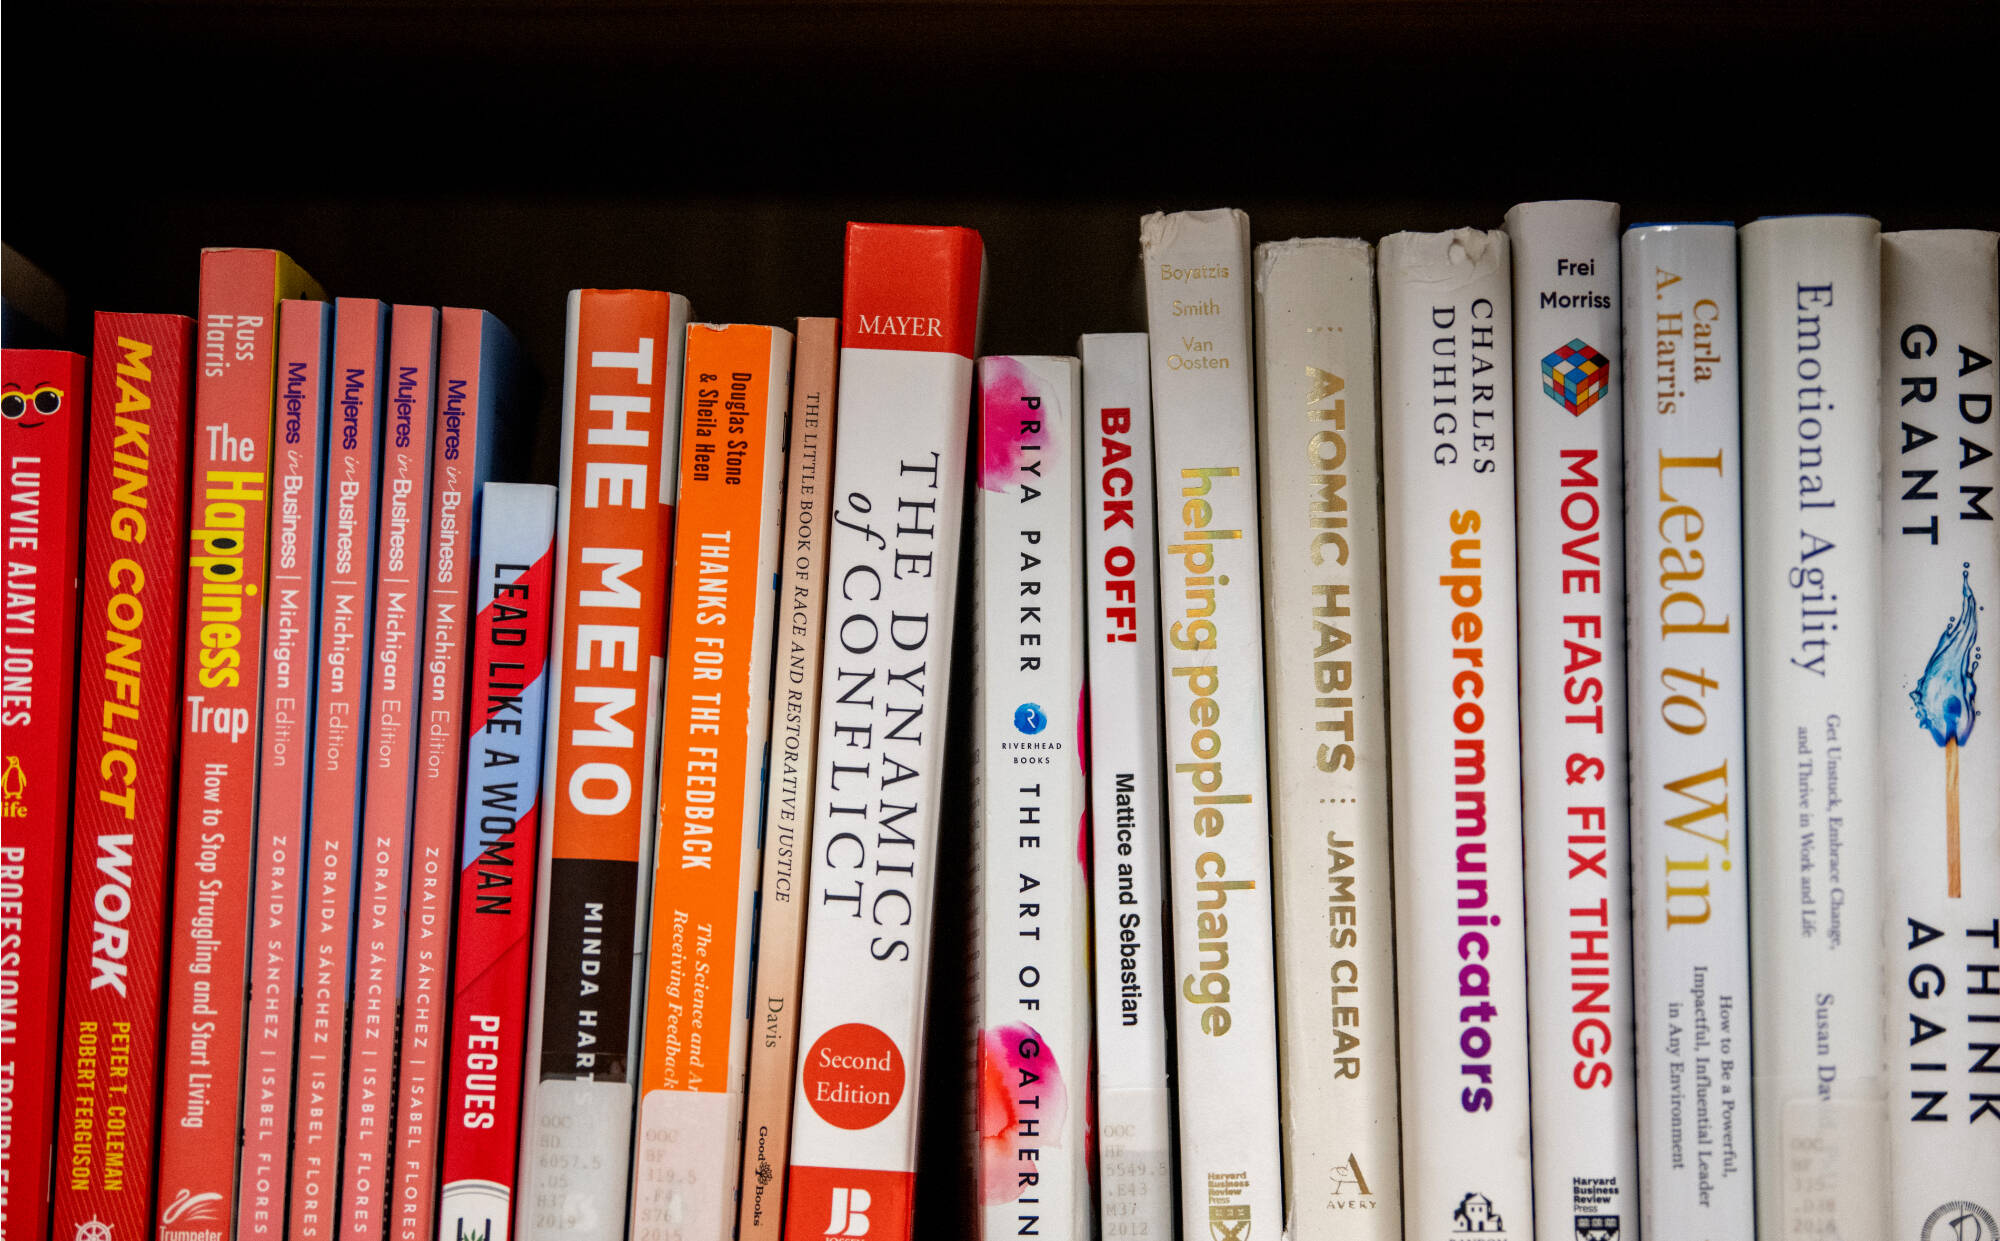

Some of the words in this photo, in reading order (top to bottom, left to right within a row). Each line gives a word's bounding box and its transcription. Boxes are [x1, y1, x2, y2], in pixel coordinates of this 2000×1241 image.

[1160, 264, 1230, 282] Boyatzis
[1540, 291, 1611, 309] Morriss
[1557, 258, 1595, 276] Frei
[1655, 267, 1683, 303] A.
[236, 315, 263, 361] Russ
[857, 314, 943, 338] MAYER
[1171, 300, 1221, 317] Smith
[1693, 298, 1720, 383] Carla
[205, 314, 234, 378] Harris
[1166, 354, 1230, 370] Oosten
[1182, 337, 1214, 352] Van
[1657, 311, 1685, 415] Harris
[283, 362, 307, 444] Mujeres
[442, 379, 467, 461] Mujeres
[697, 389, 718, 438] Sheila
[725, 373, 752, 434] Douglas
[805, 392, 820, 428] THE
[1432, 305, 1458, 466] DUHIGG
[1471, 297, 1496, 474] CHARLES
[1797, 282, 1836, 511] Emotional
[110, 336, 152, 544] MAKING
[206, 423, 255, 463] The
[584, 337, 654, 510] THE
[1020, 396, 1041, 504] PRIYA
[1900, 324, 1939, 545] GRANT
[1958, 344, 1994, 523] ADAM
[694, 443, 715, 482] Heen
[726, 440, 748, 486] Stone
[801, 434, 818, 495] LITTLE
[1100, 406, 1134, 532] BACK
[1305, 366, 1349, 568] ATOMIC
[9, 457, 41, 551] LUVVIE
[280, 475, 303, 569] Business
[438, 491, 461, 583] Business
[797, 501, 813, 551] BOOK
[834, 491, 886, 551] of
[893, 451, 940, 580] THE
[1559, 449, 1600, 594] MOVE
[191, 471, 264, 688] Happiness
[696, 530, 731, 627] THANKS
[796, 557, 809, 582] OF
[1167, 466, 1243, 652] helping
[1658, 448, 1730, 642] Lead
[6, 562, 37, 634] AJAYI
[492, 562, 529, 647] LEAD
[791, 586, 809, 637] RACE
[1020, 529, 1041, 672] PARKER
[1104, 545, 1137, 644] OFF!
[1788, 530, 1839, 678] Agility
[273, 589, 300, 689] Michigan
[429, 603, 456, 701] Michigan
[692, 638, 724, 682] FOR
[790, 640, 805, 684] AND
[1562, 615, 1604, 734] FAST
[1, 645, 33, 727] JONES
[100, 558, 145, 819] CONFLICT
[485, 662, 525, 738] LIKE
[568, 547, 643, 815] MEMO
[689, 691, 721, 735] THE
[1311, 584, 1355, 773] HABITS
[1660, 667, 1720, 736] to
[188, 696, 249, 743] Trap
[274, 697, 295, 767] Edition
[428, 710, 450, 778] Edition
[781, 689, 803, 821] RESTORATIVE
[823, 564, 881, 918] CONFLICT
[1001, 742, 1062, 750] RIVERHEAD
[1172, 665, 1252, 838] people
[1797, 727, 1813, 755] and
[1826, 714, 1840, 742] Get
[204, 763, 228, 802] How
[483, 749, 520, 768] A
[870, 610, 929, 962] DYNAMICS
[1013, 756, 1051, 765] BOOKS
[1565, 753, 1605, 786] &
[1798, 759, 1813, 808] Thrive
[203, 808, 222, 826] to
[681, 746, 719, 871] FEEDBACK
[1019, 783, 1041, 849] THE
[1115, 773, 1135, 858] Mattice
[1439, 508, 1500, 1113] supercommunicators
[1567, 806, 1606, 880] FIX
[195, 833, 225, 873] Stop
[475, 782, 518, 916] WOMAN
[776, 824, 794, 903] JUSTICE
[1662, 758, 1732, 931] Win
[1800, 832, 1815, 872] Work
[1829, 816, 1843, 883] Embrace
[90, 834, 133, 998] WORK
[269, 836, 286, 929] ZORAIDA
[420, 847, 439, 939] ZORAIDA
[1019, 873, 1041, 941] ART
[1118, 863, 1138, 905] and
[1326, 831, 1356, 948] JAMES
[1801, 877, 1816, 905] and
[189, 879, 222, 974] Struggling
[579, 902, 604, 998] MINDA
[666, 909, 689, 999] Receiving
[696, 923, 712, 958] The
[1182, 851, 1256, 1037] change
[1801, 910, 1816, 938] Life
[192, 981, 218, 1015] and
[264, 940, 284, 1039] SÁNCHEZ
[414, 951, 434, 1048] SÁNCHEZ
[691, 961, 710, 1029] Science
[1018, 965, 1041, 1011] OF
[1120, 913, 1141, 1027] Sebastian
[1570, 897, 1613, 1090] THINGS
[190, 1021, 215, 1067] Start
[766, 996, 784, 1048] Davis
[1330, 959, 1360, 1080] CLEAR
[1666, 1024, 1683, 1057] Any
[1669, 1003, 1683, 1018] in
[1690, 966, 1710, 1051] Impactful,
[1720, 995, 1732, 1029] How
[1815, 993, 1834, 1056] Susan
[1908, 918, 1948, 1123] AGAIN
[1966, 919, 2000, 1124] THINK
[77, 1021, 98, 1090] ROBERT
[111, 1022, 131, 1078] PETER
[463, 1015, 500, 1130] PEGUES
[663, 1002, 683, 1089] Feedback
[689, 1033, 704, 1068] and
[819, 1047, 892, 1071] Second
[1720, 1034, 1731, 1055] to
[1721, 1060, 1734, 1080] Be
[108, 1084, 128, 1098] T.
[181, 1074, 212, 1129] Living
[259, 1068, 276, 1140] ISABEL
[408, 1077, 424, 1148] ISABEL
[816, 1081, 890, 1105] Edition
[1670, 1062, 1684, 1170] Environment
[1696, 1057, 1713, 1144] Influential
[71, 1097, 94, 1190] FERGUSON
[104, 1105, 126, 1191] COLEMAN
[758, 1126, 768, 1161] Good
[1722, 1100, 1737, 1178] Powerful,
[254, 1153, 271, 1234] FLORES
[402, 1161, 419, 1240] FLORES
[753, 1185, 764, 1227] Books
[1326, 1201, 1377, 1209] AVERY
[1573, 1177, 1616, 1186] Harvard
[1573, 1186, 1619, 1195] Business
[1573, 1195, 1611, 1204] Review
[1573, 1204, 1598, 1213] Press
[1698, 1151, 1714, 1208] Leader
[159, 1226, 223, 1241] Trumpeter
